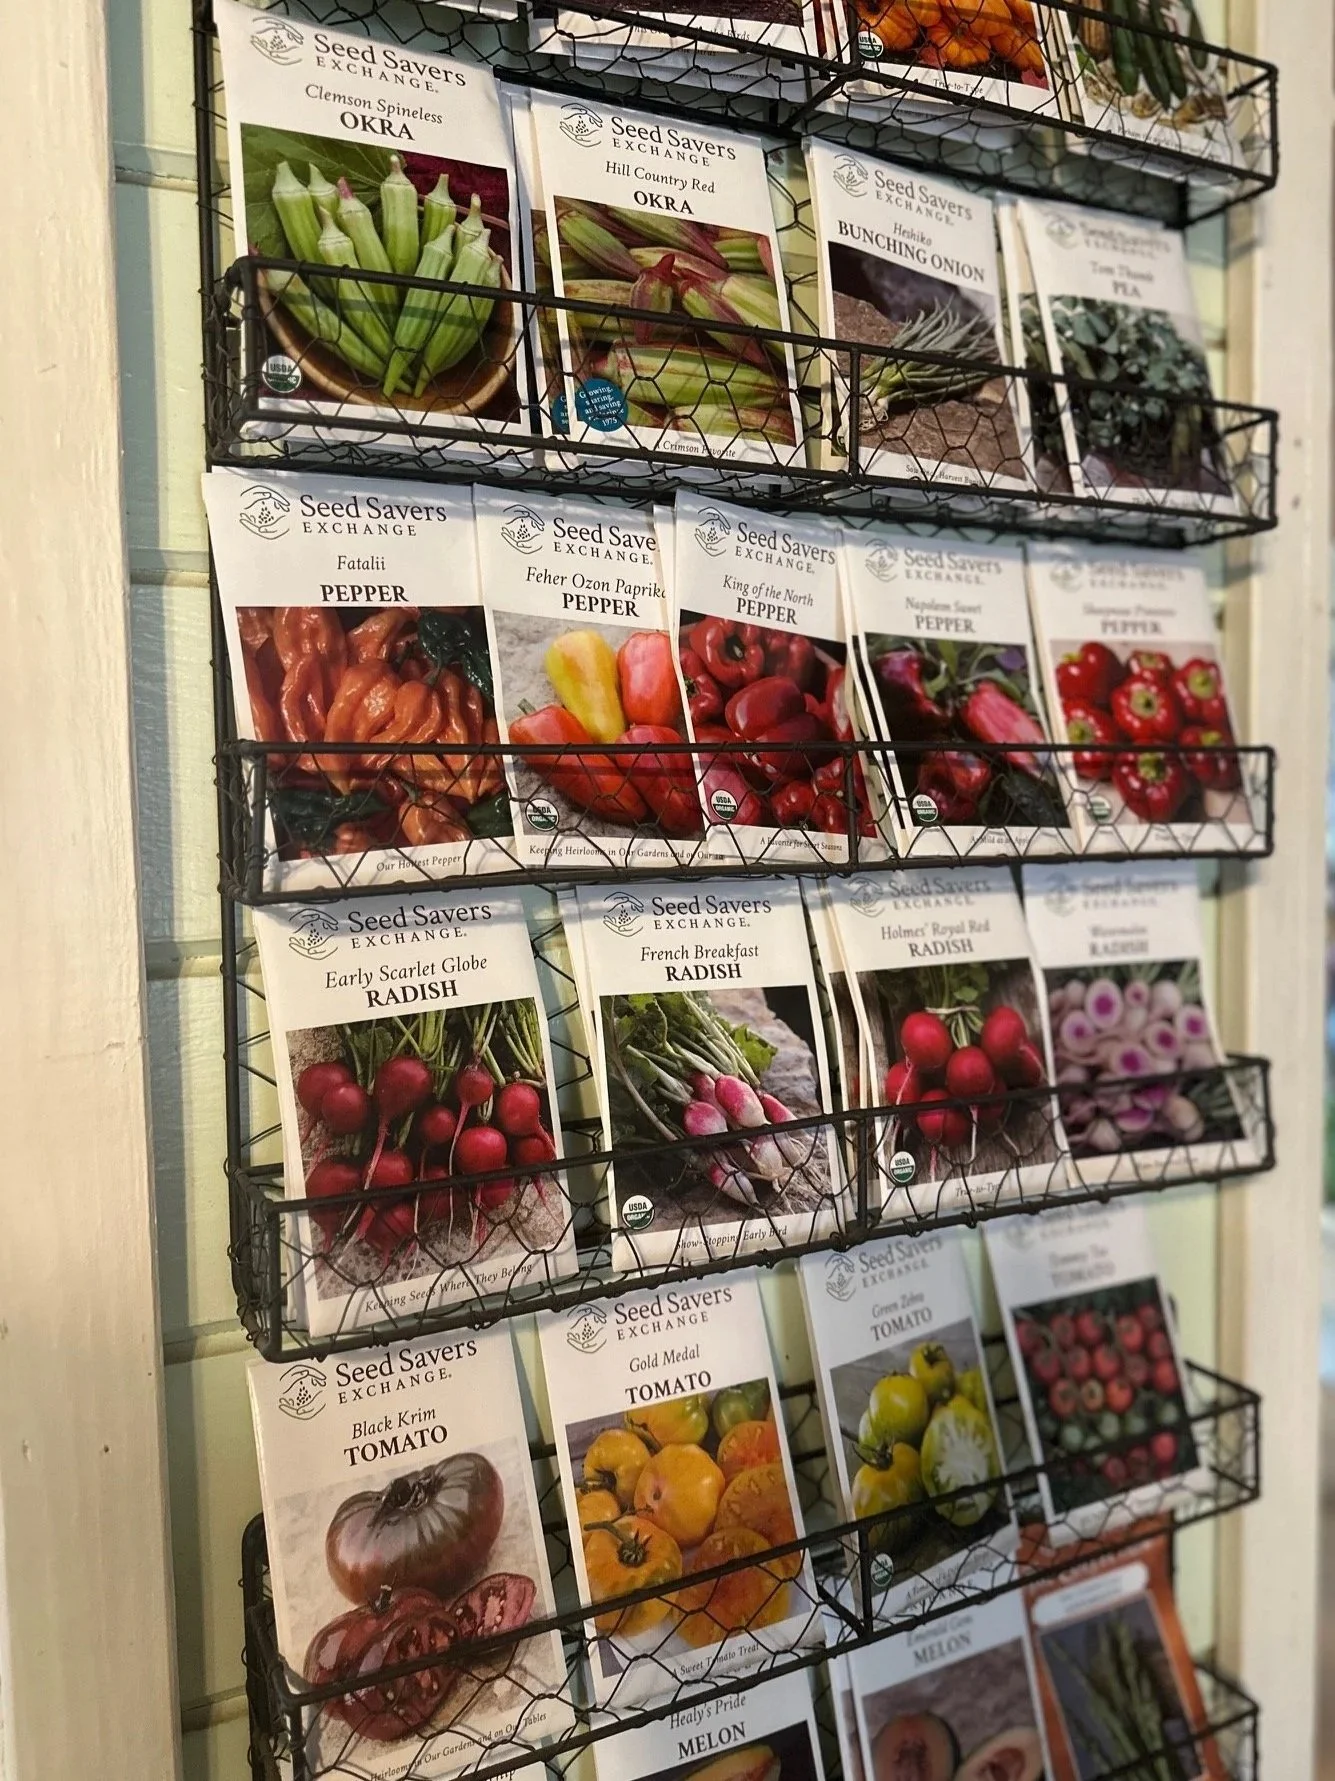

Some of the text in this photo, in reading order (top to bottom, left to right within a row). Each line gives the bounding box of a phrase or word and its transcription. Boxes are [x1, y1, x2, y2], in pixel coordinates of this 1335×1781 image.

[314, 33, 467, 87] Seed Savers
[305, 84, 443, 125] Clemson Spineless
[340, 111, 415, 141] OKRA
[612, 117, 736, 160] Seed Savers
[605, 161, 716, 194] Hill Country Red
[633, 190, 694, 215] OKRA
[874, 170, 972, 221] Seed Savers
[838, 220, 985, 283] BUNCHING ONION
[579, 386, 613, 398] Gowing,
[602, 417, 617, 426] 1975
[663, 441, 699, 453] Crimson
[702, 445, 735, 457] Favoite
[300, 494, 447, 522] Seed Savers
[553, 517, 660, 553] Seed Save
[737, 522, 836, 565] Seed Savers
[337, 555, 386, 571] Fatalii
[904, 547, 943, 568] Seed
[320, 584, 408, 602] PEPPER
[526, 566, 567, 586] Feher
[572, 573, 610, 592] Ozon
[723, 575, 813, 607] King of the North
[562, 593, 640, 617] PEPPER
[736, 597, 798, 625] PEPPER
[915, 615, 976, 634] PEPPER
[715, 796, 731, 804] USDA
[530, 845, 562, 856] Keepng
[637, 849, 668, 858] Gardens
[760, 837, 765, 845] A
[377, 863, 395, 871] Our
[432, 855, 462, 866] Pepper
[888, 877, 991, 898] Seed Savers
[348, 905, 492, 933] Seed Savers
[652, 895, 772, 916] Seed Savers
[932, 921, 965, 939] Royal
[969, 920, 991, 933] Red
[640, 943, 759, 961] French Breakfast
[908, 938, 974, 958] RADISH
[325, 954, 488, 990] Early Scarlet Globe
[665, 963, 742, 982] RADISH
[366, 979, 458, 1009] RADISH
[895, 1158, 910, 1166] USDA
[629, 1202, 647, 1211] USDA
[744, 1229, 766, 1240] Early
[858, 1243, 895, 1274] Seed
[475, 1271, 498, 1285] They
[501, 1263, 532, 1278] Belng
[614, 1287, 733, 1325] Seed Savers
[870, 1307, 933, 1342] TOMATO
[336, 1339, 478, 1387] Seed Savers
[629, 1344, 700, 1373] Gold Medal
[625, 1370, 712, 1405] TOMATO
[352, 1408, 437, 1440] Black Krim
[344, 1424, 448, 1467] TOMATO
[680, 1661, 703, 1675] Sweet
[738, 1643, 759, 1656] Treat
[913, 1630, 972, 1667] MELON
[715, 1694, 746, 1715] Pride
[425, 1752, 441, 1763] Our
[523, 1713, 546, 1727] Tables
[679, 1721, 746, 1760] MELON
